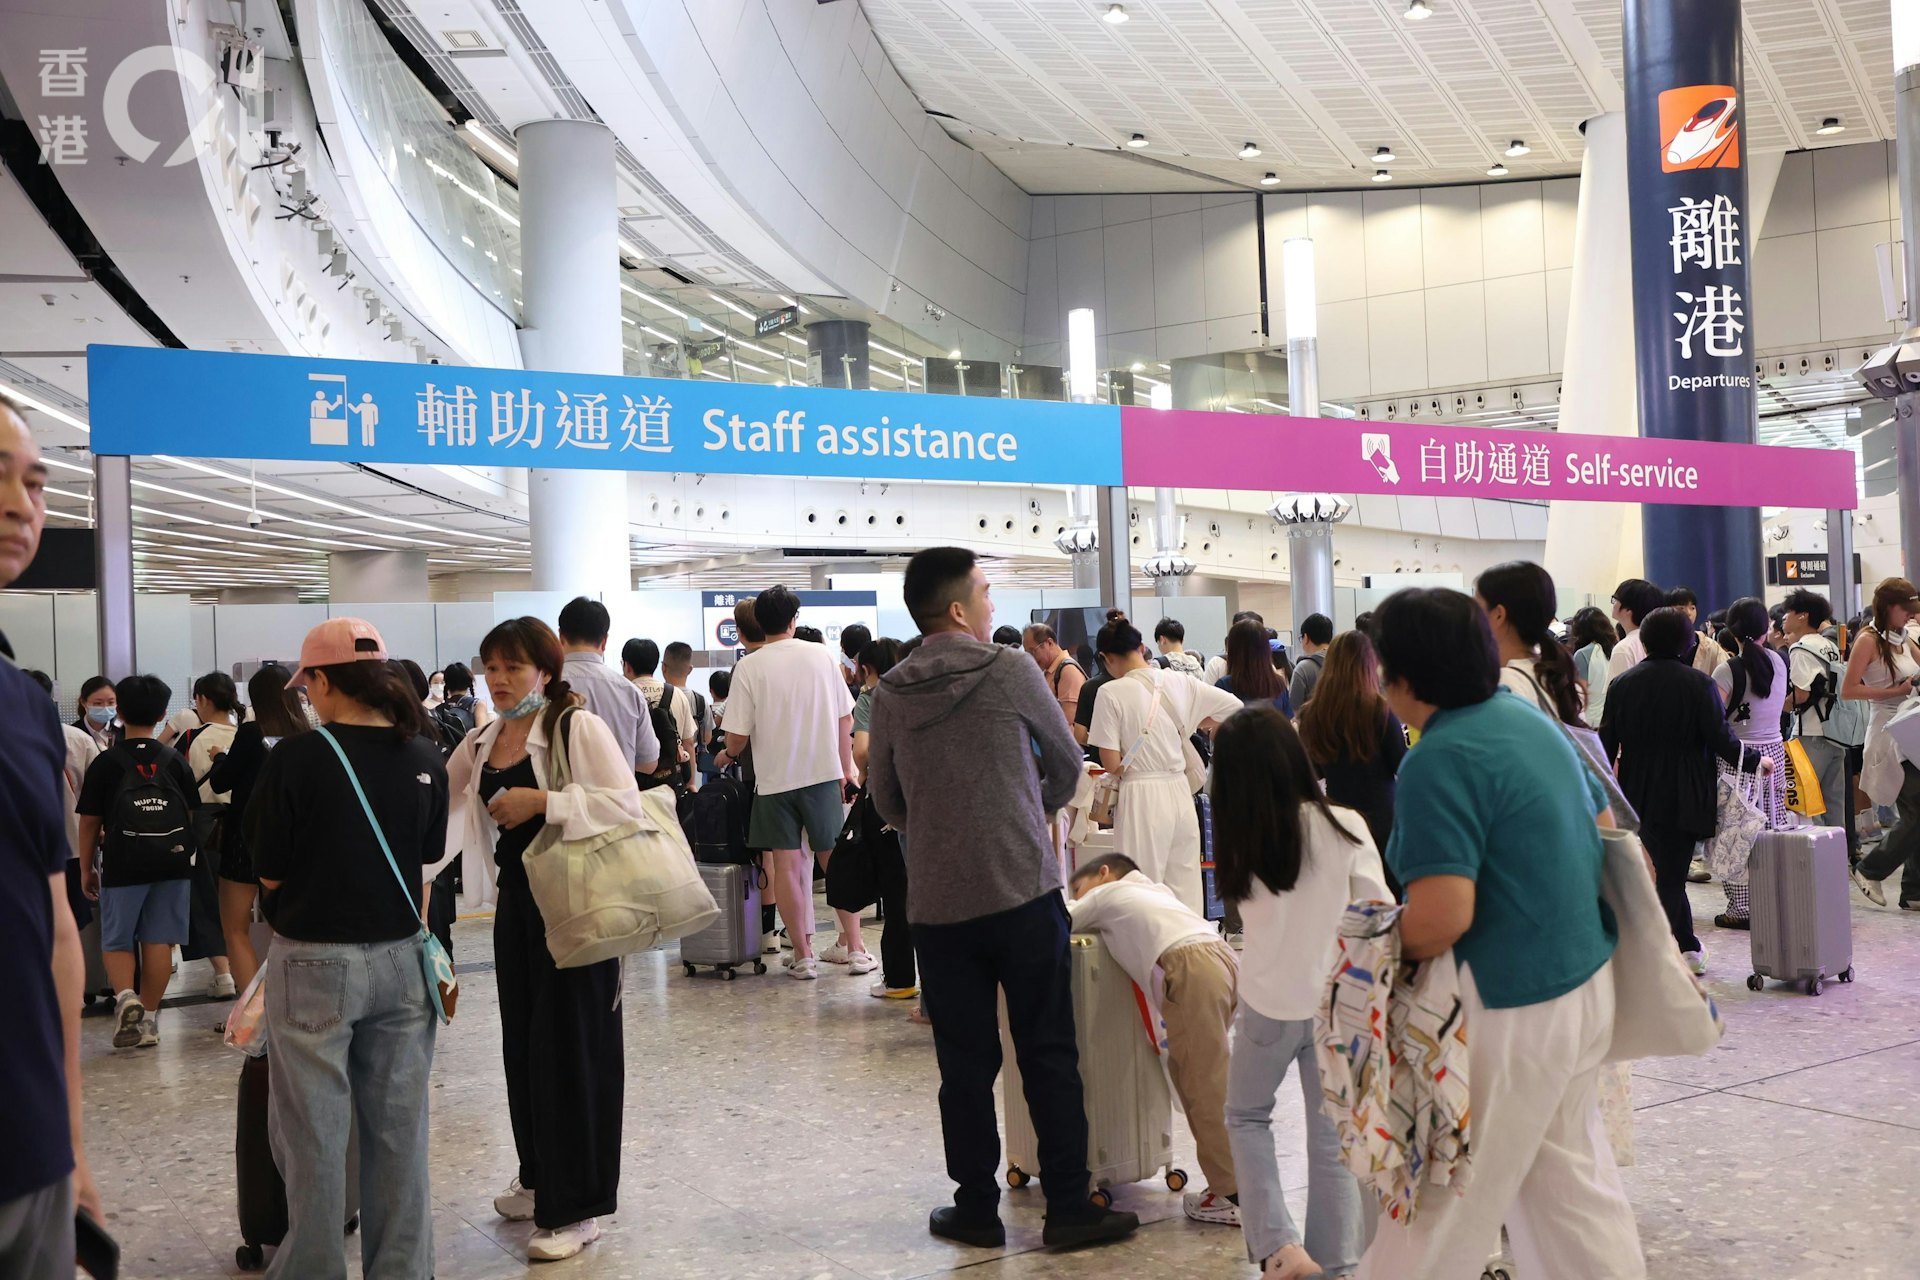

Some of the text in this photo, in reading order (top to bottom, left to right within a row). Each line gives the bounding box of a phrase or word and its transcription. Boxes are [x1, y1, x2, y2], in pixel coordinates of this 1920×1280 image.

[1667, 194, 1745, 359] 離港
[1668, 372, 1750, 391] Departures
[415, 383, 674, 453] 輔助通道
[702, 408, 1018, 462] Staff assistance
[1420, 438, 1551, 486] 自助通道
[1566, 453, 1698, 489] Self-service
[714, 594, 735, 606] 離港
[133, 798, 168, 806] NUPTSE
